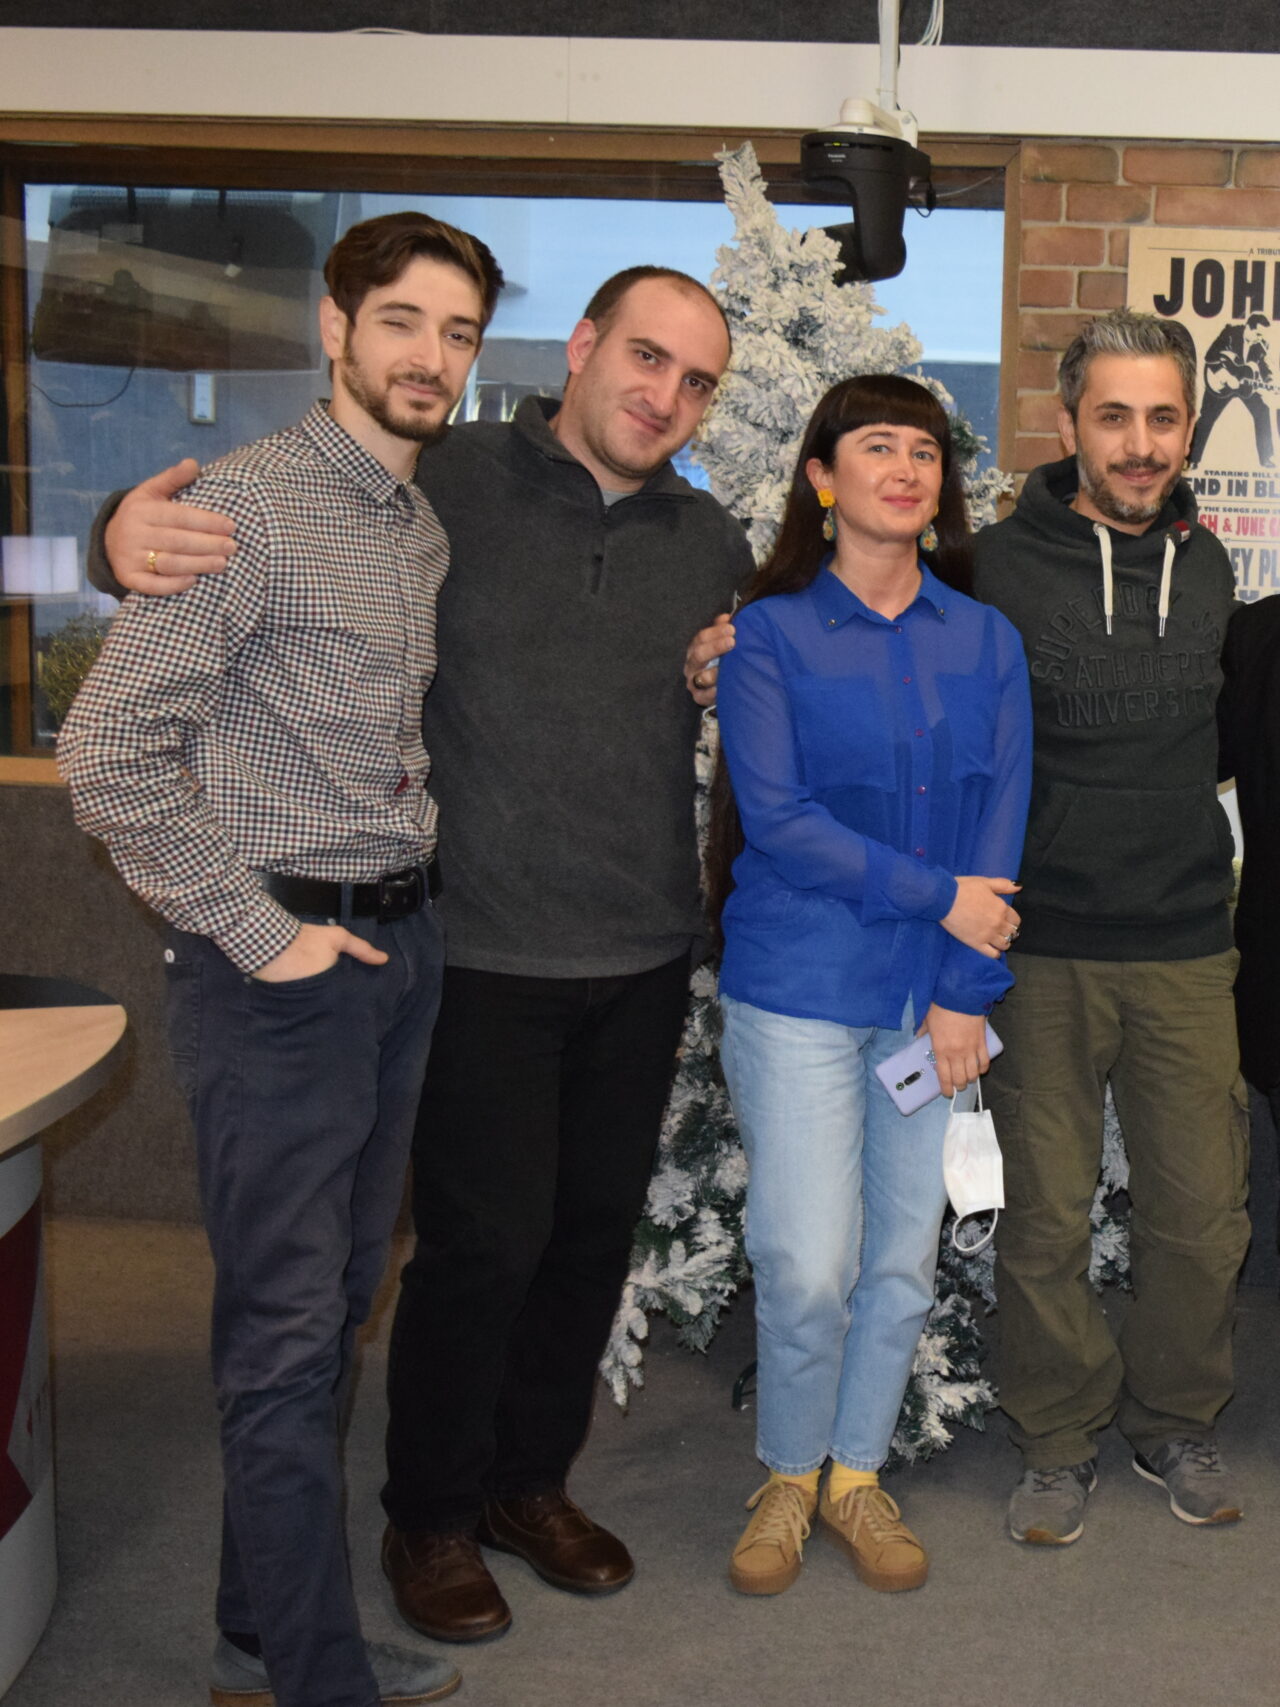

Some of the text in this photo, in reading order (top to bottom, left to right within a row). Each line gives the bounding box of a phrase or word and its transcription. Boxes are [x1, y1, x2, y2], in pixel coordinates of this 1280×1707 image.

[1204, 470, 1250, 478] STARRING
[1184, 478, 1221, 497] ND
[1227, 479, 1249, 498] IN
[1222, 506, 1250, 514] SONGS
[1222, 517, 1233, 533] &
[1235, 516, 1266, 537] JUNE
